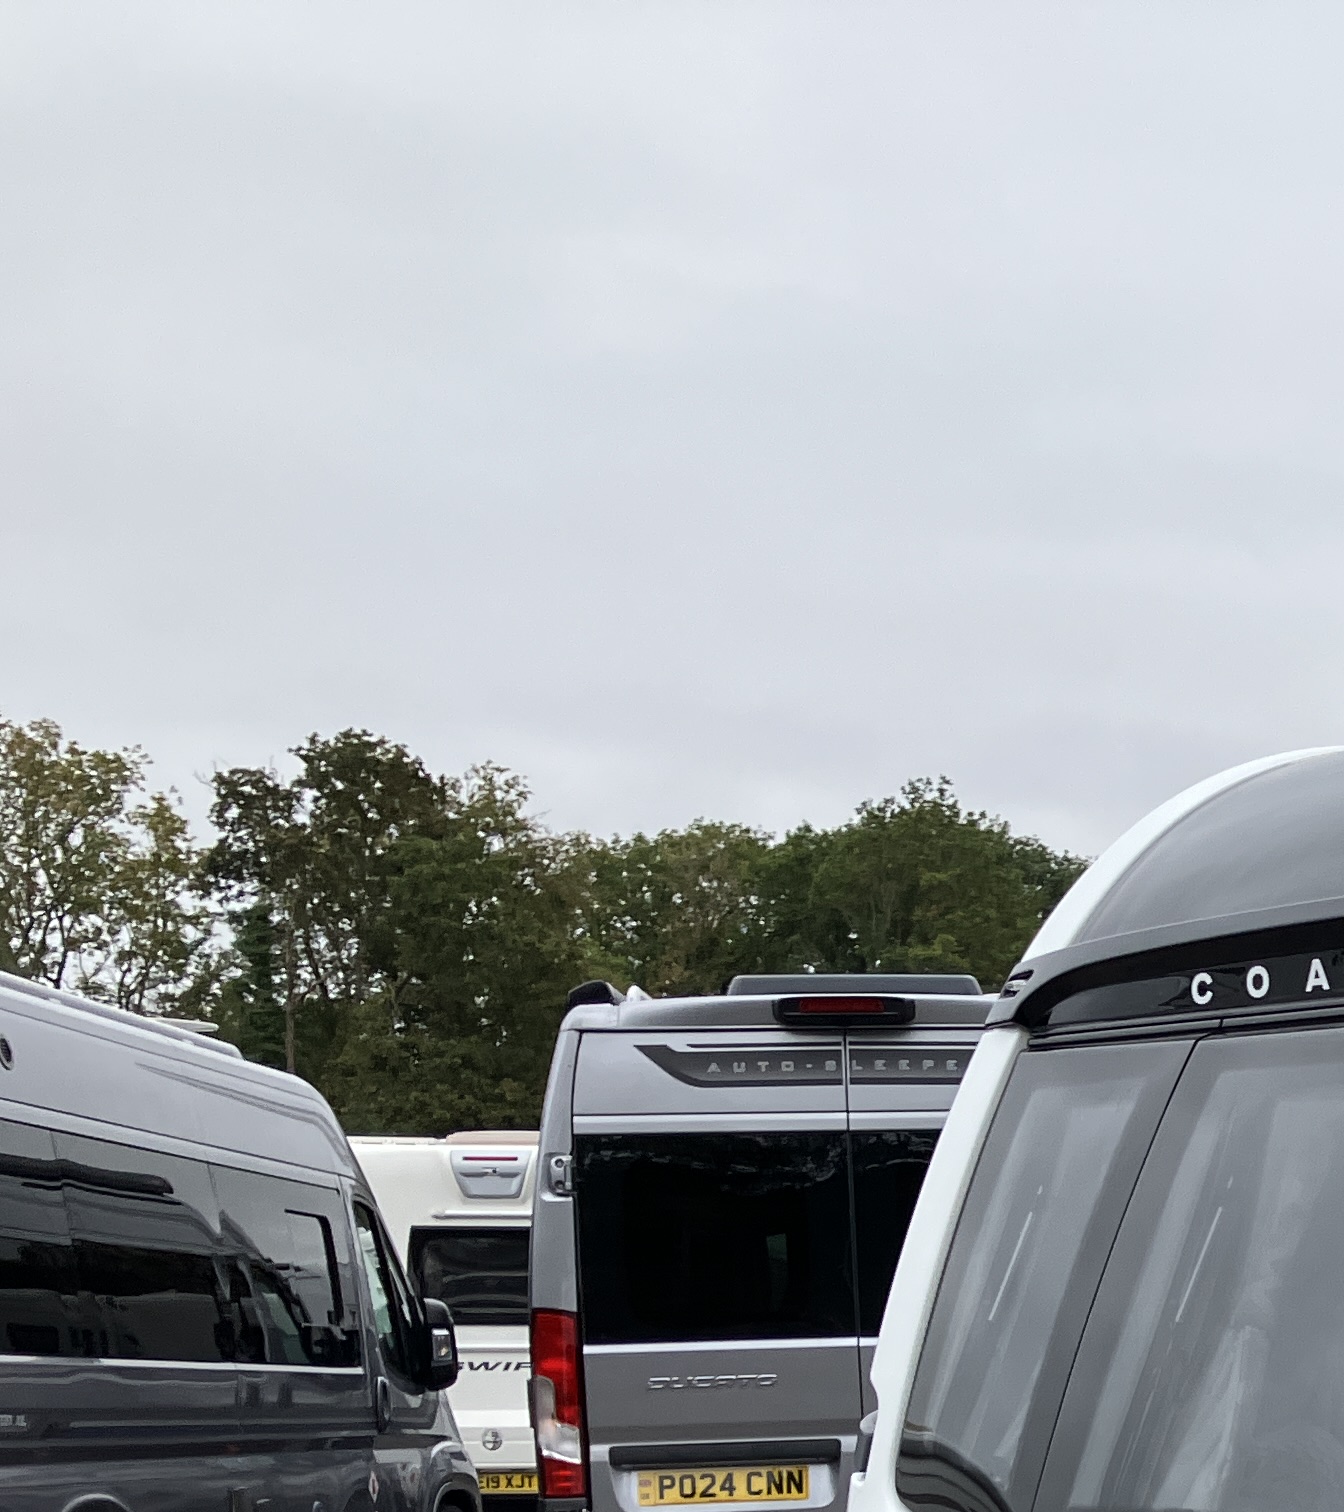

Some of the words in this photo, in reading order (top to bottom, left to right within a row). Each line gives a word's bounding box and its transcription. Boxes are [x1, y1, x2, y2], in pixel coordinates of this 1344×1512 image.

[647, 1373, 778, 1389] DUCATO
[505, 1474, 534, 1489] XJT
[658, 1473, 736, 1500] PO24
[746, 1469, 804, 1496] CNN
